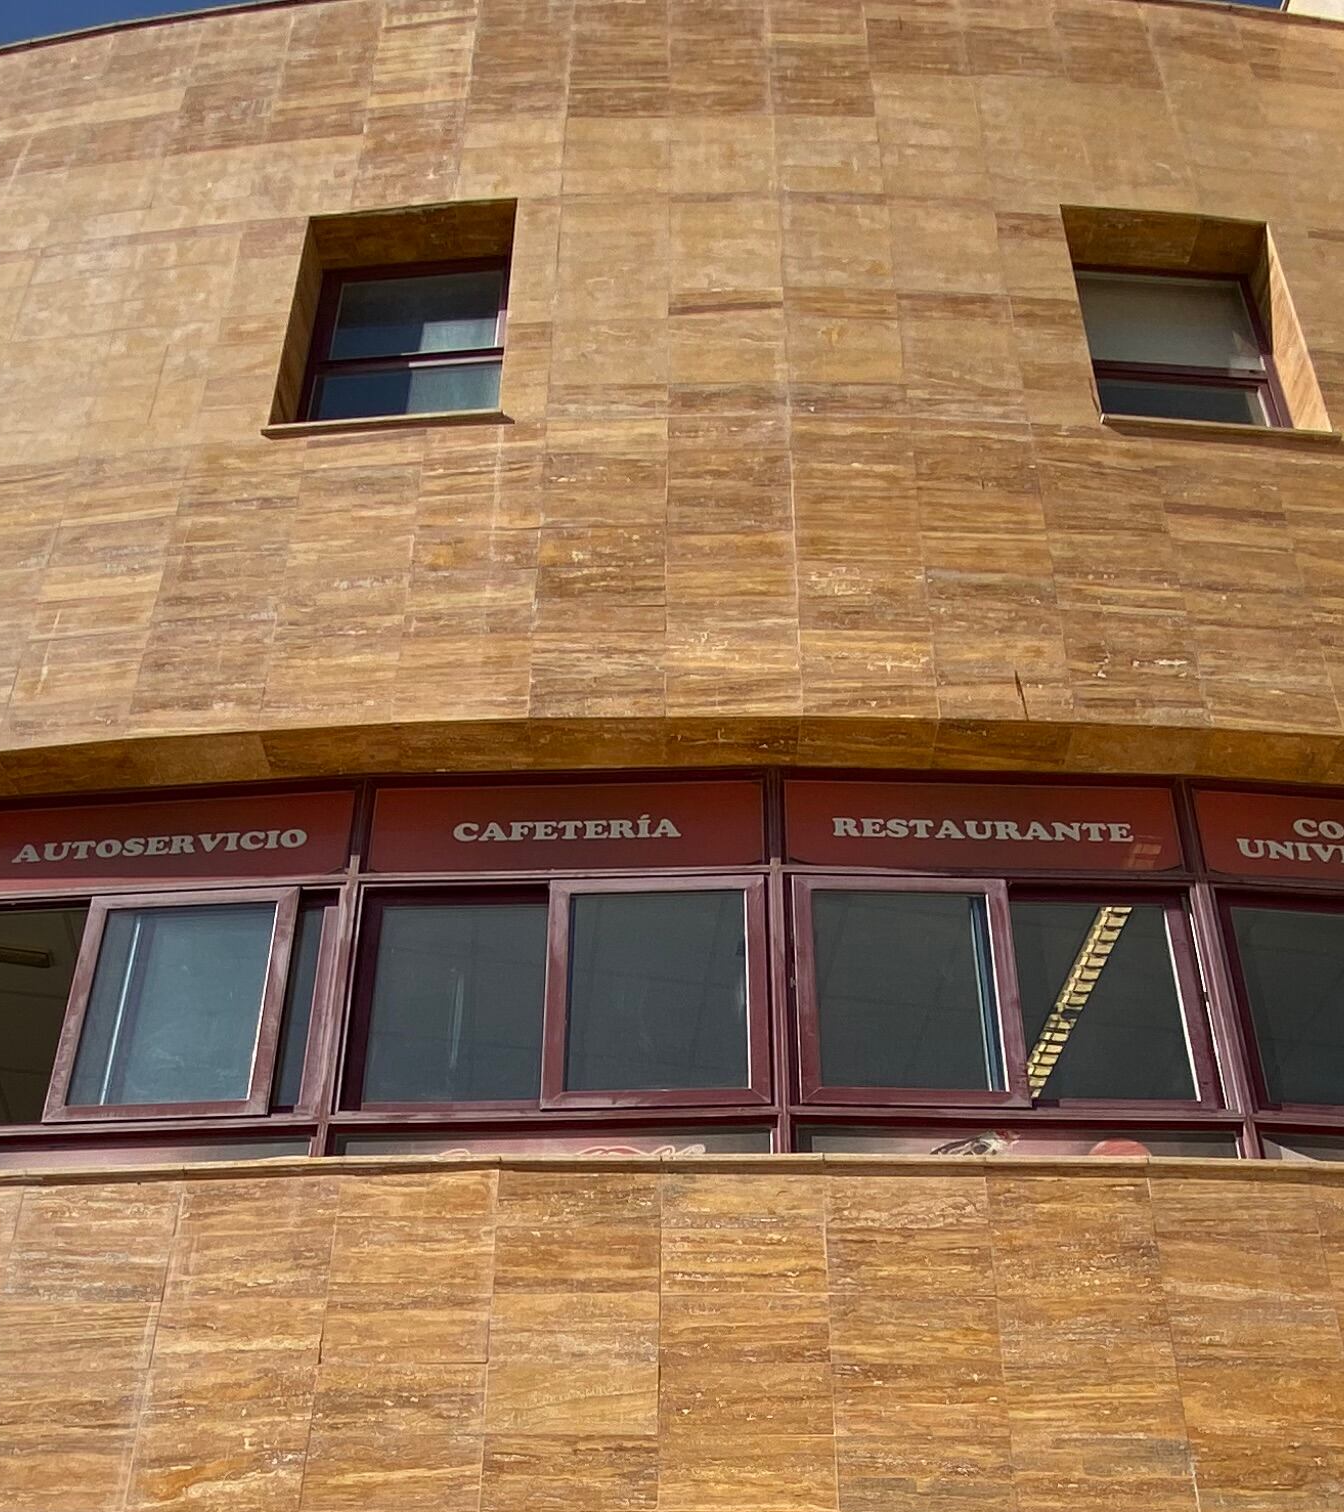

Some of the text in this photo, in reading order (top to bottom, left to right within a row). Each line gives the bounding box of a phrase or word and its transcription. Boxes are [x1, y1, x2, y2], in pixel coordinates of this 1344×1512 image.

[453, 804, 682, 842] CAFETERÍA
[831, 817, 1135, 843] RESTAURANTE
[12, 829, 307, 863] AUTOSERVICIO
